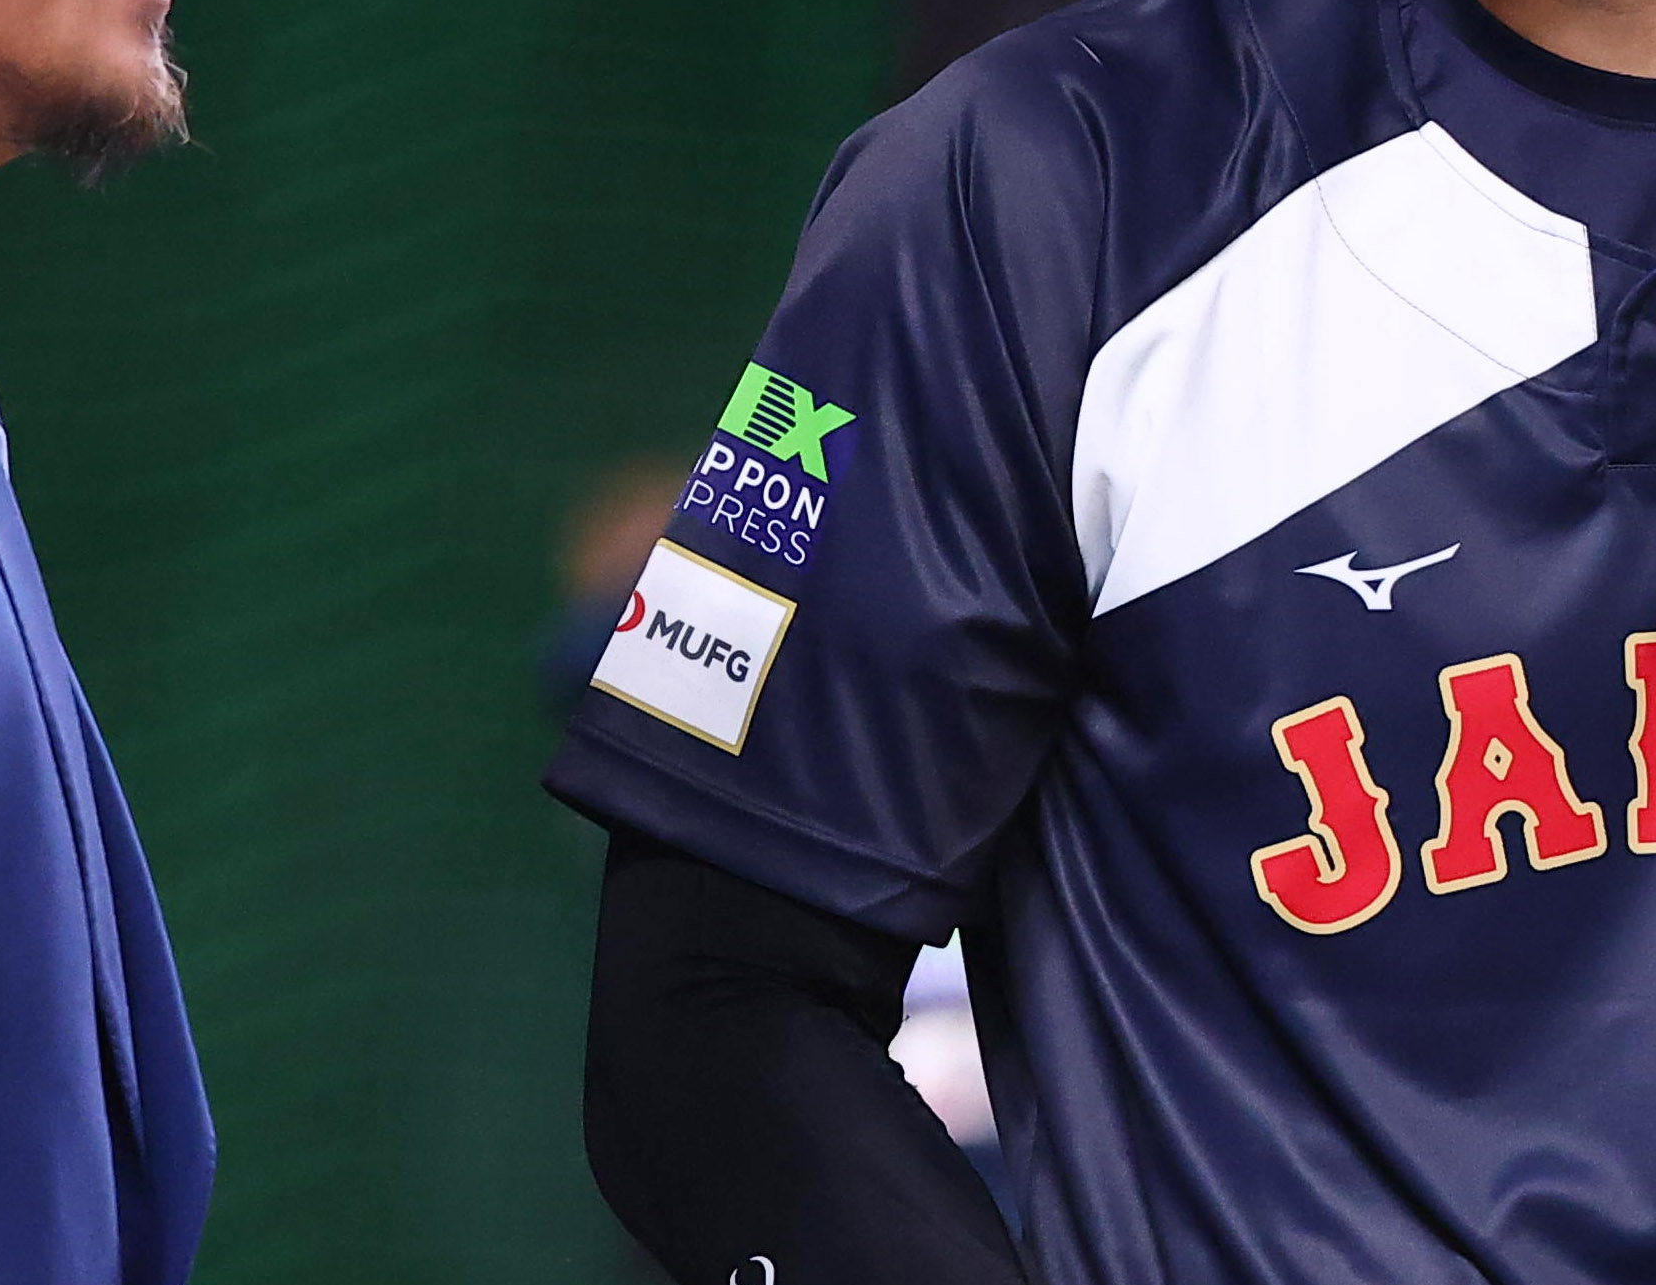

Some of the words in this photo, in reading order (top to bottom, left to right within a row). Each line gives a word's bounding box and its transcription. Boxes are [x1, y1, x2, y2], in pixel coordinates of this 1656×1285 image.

[674, 479, 811, 565] PRESS
[693, 441, 825, 530] PPON
[646, 610, 751, 682] MUFG
